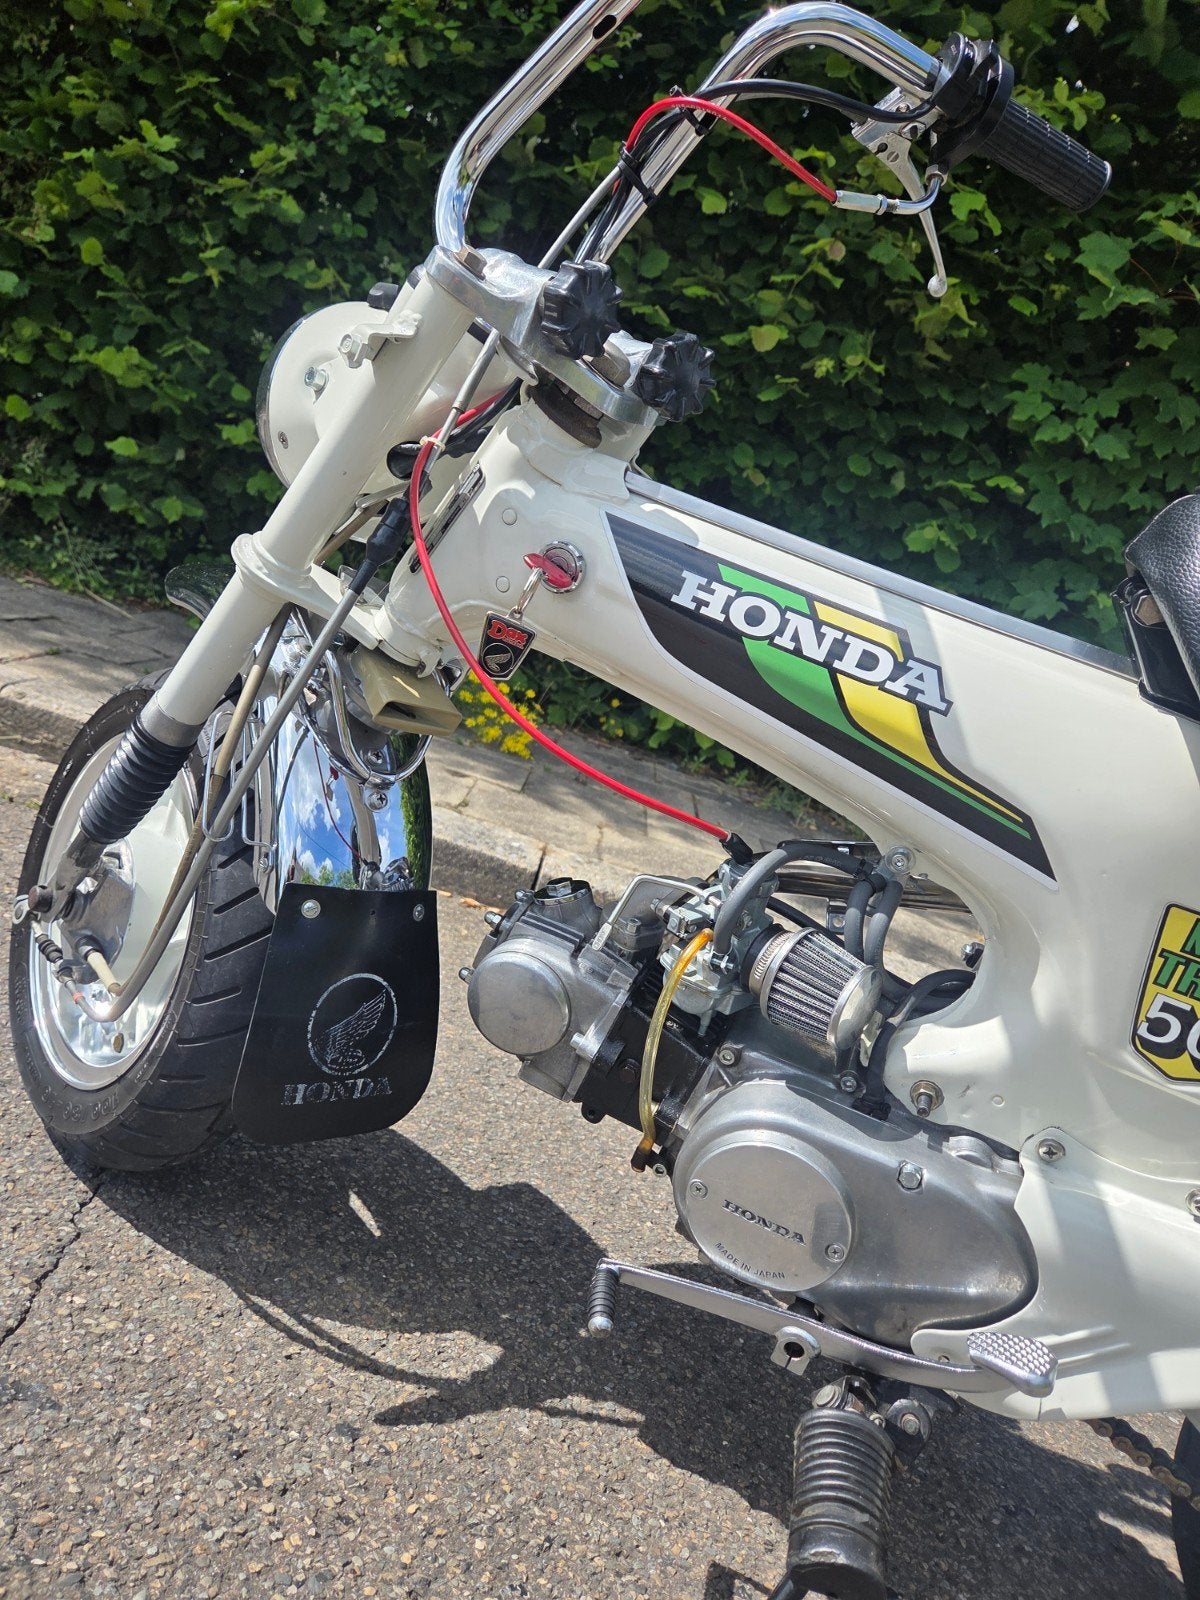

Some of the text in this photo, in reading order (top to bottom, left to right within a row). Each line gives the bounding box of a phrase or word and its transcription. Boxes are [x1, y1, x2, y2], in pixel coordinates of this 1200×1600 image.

[488, 620, 528, 645] Dax
[670, 571, 953, 714] HONDA
[281, 1077, 392, 1106] HONDA
[722, 1199, 806, 1246] HONDA
[715, 1242, 786, 1279] MADE IN JAPAN
